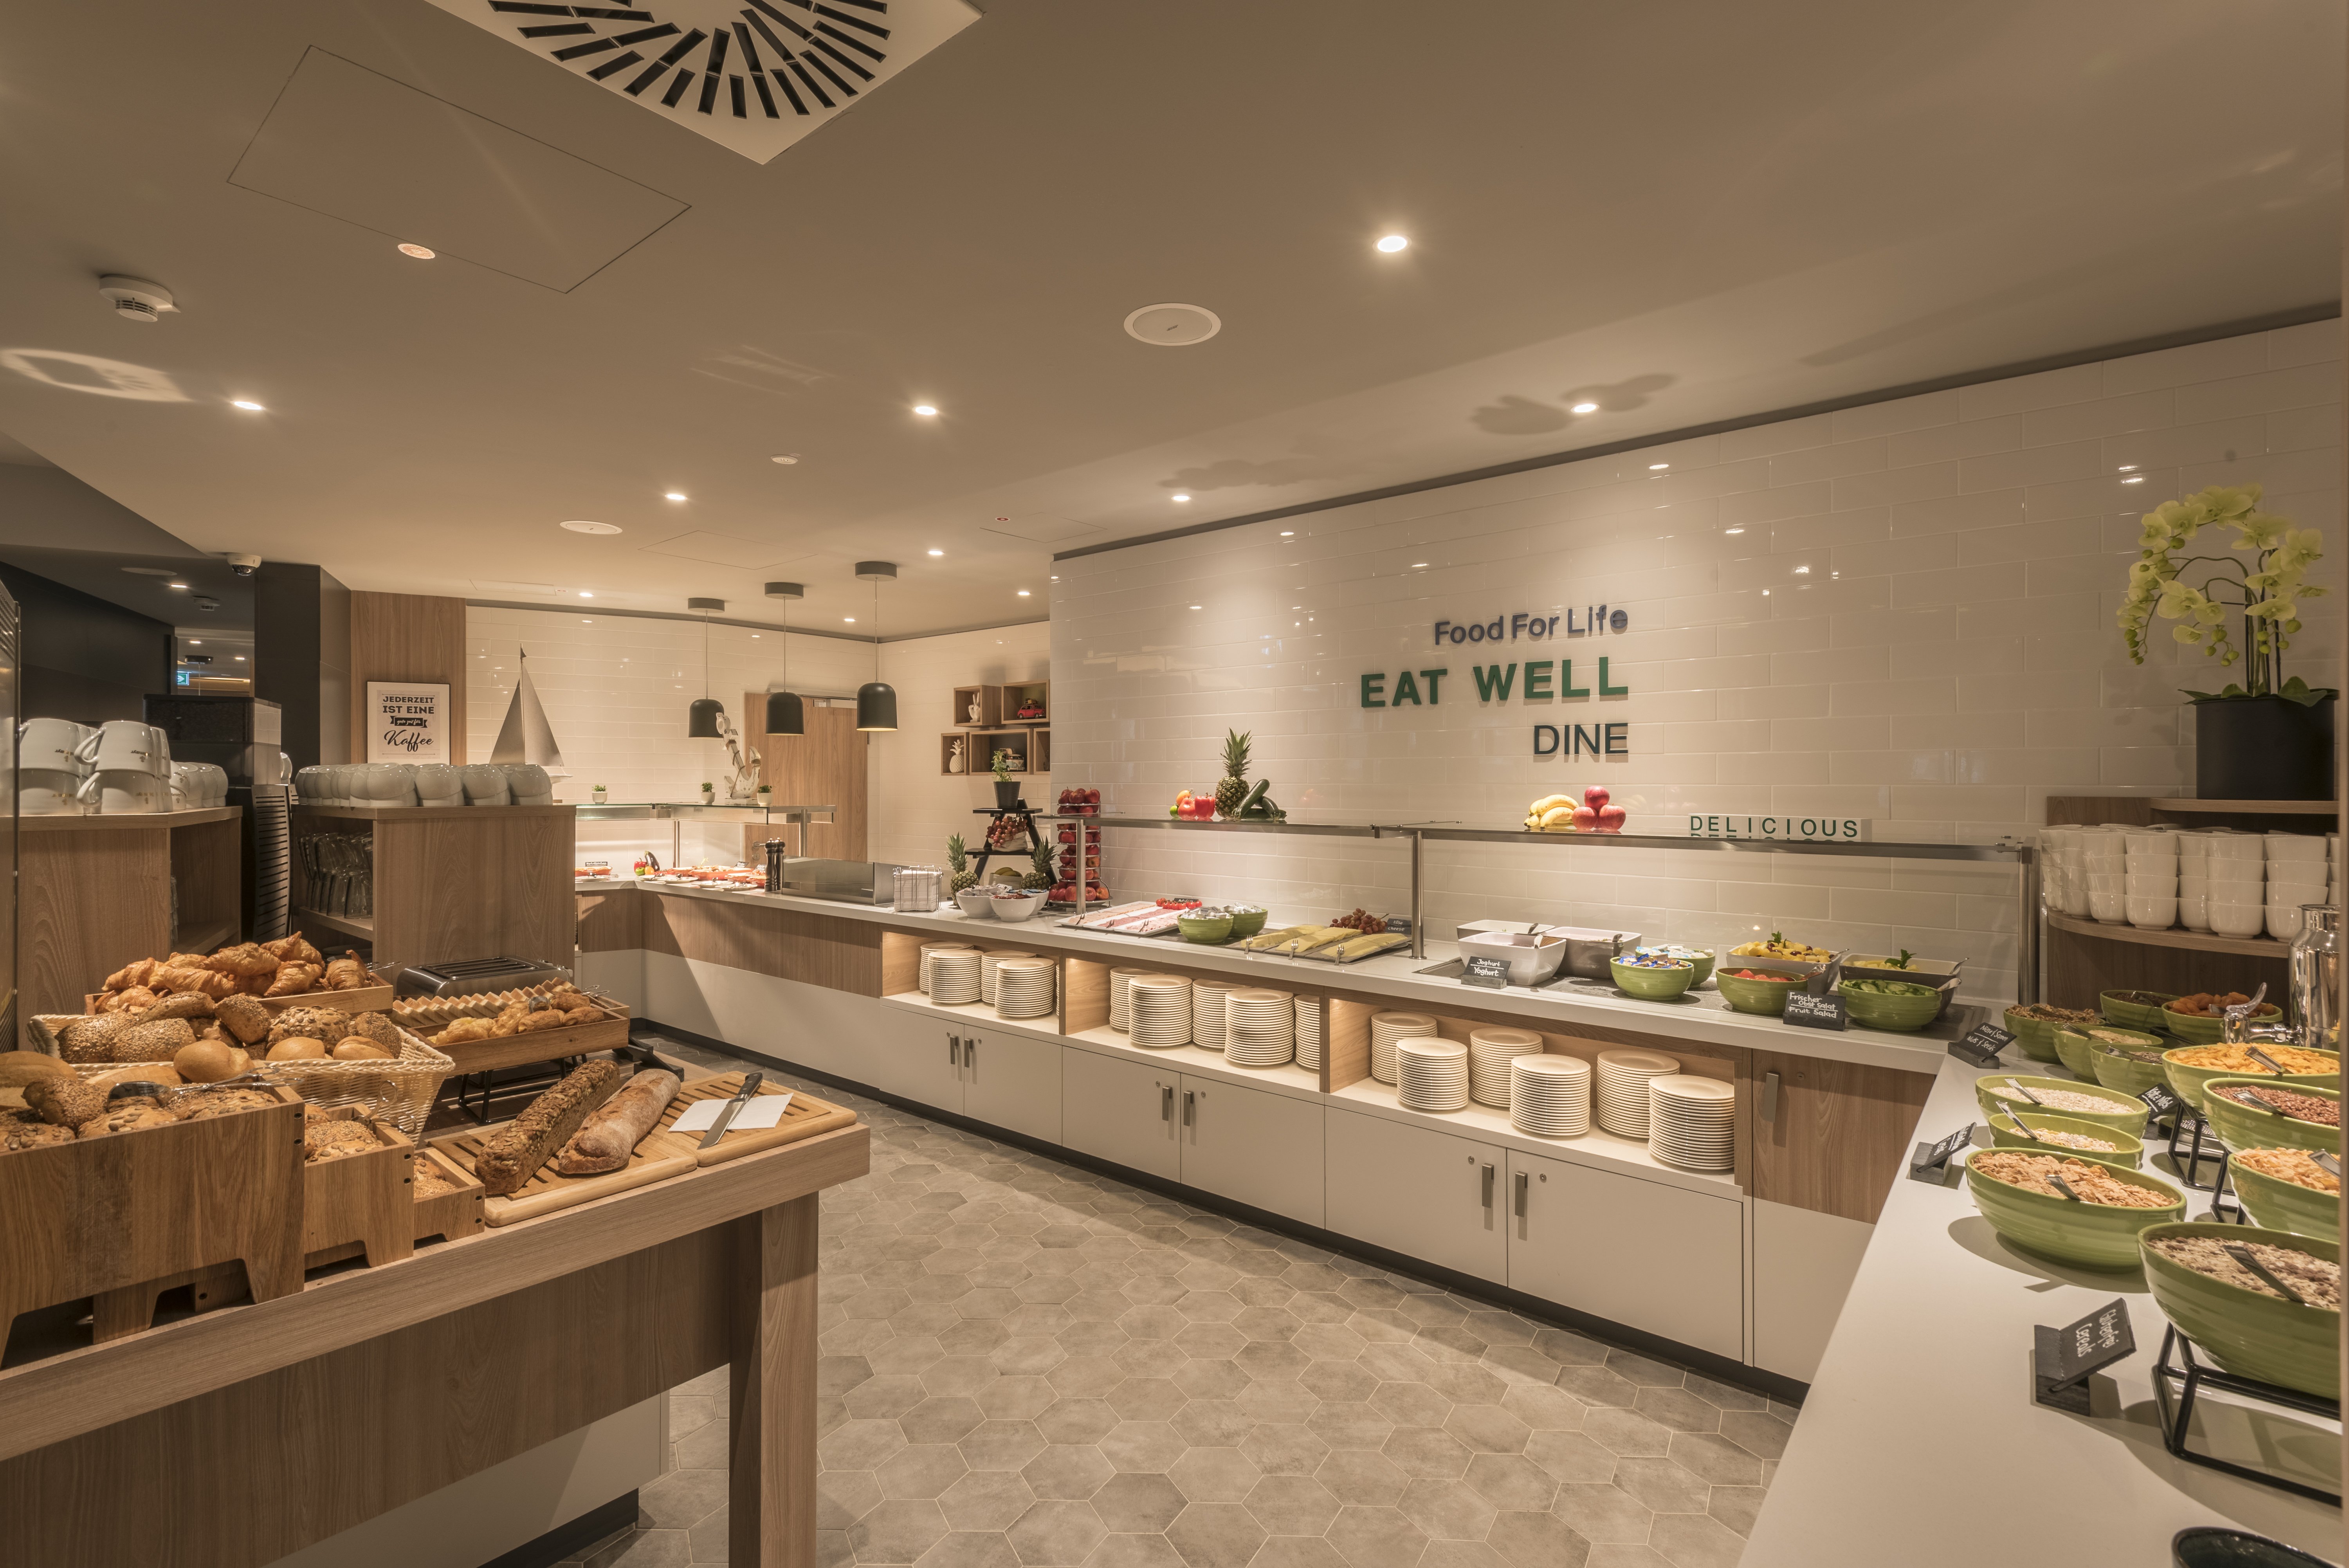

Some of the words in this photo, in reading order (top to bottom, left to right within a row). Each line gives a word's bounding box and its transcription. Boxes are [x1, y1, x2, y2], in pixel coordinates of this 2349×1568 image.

[1435, 616, 1504, 645] Food
[1512, 613, 1560, 639] For
[1568, 605, 1628, 633] Life
[1361, 668, 1448, 708] EAT
[1472, 656, 1628, 702] WELL
[382, 705, 403, 714] IST
[384, 729, 434, 752] Kaffee
[1533, 722, 1629, 755] DINE
[1690, 816, 1858, 838] DELICIOUS
[1474, 966, 1499, 977] Yoghurt
[1476, 959, 1500, 967] Joghurt
[1789, 992, 1823, 1003] Frischer
[1813, 1009, 1837, 1018] Salad
[2097, 1309, 2119, 1348] Glutenfrei
[2076, 1323, 2096, 1357] Cereals
